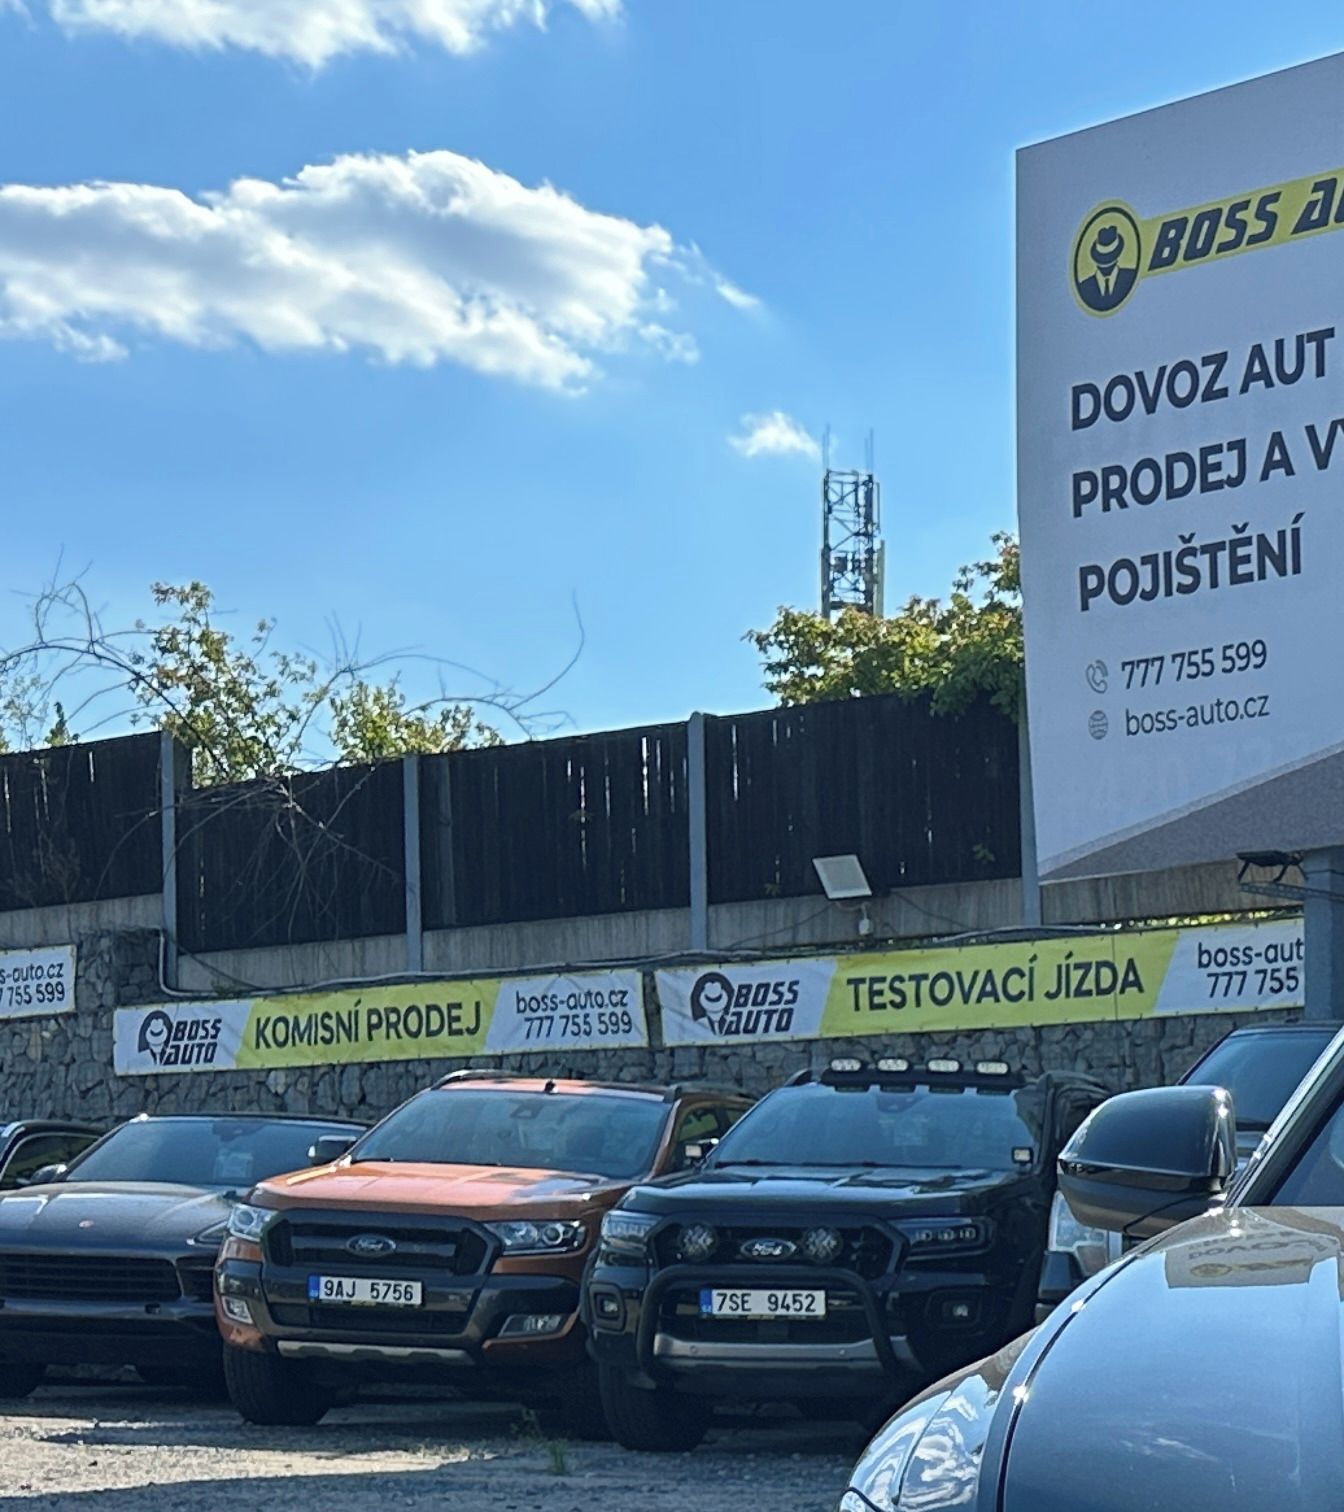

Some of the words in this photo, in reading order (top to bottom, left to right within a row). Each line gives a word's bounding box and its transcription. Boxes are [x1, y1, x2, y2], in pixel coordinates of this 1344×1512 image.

[1148, 192, 1282, 272] BOSS
[1071, 351, 1229, 430] DOVOZ
[1239, 327, 1336, 395] AUT
[1072, 440, 1246, 518] PRODEJ
[1260, 432, 1295, 482] A
[1078, 512, 1306, 611] POJIŠTĚNÍ
[1120, 659, 1166, 690] 777
[1171, 651, 1216, 682] 755
[1220, 639, 1268, 675] 599
[1125, 694, 1270, 737] boss-auto.cz
[7, 984, 33, 1007] 755
[36, 981, 66, 1003] 599
[734, 980, 800, 1008] BOSS
[846, 954, 1036, 1012] TESTOVACÍ
[1044, 952, 1145, 999] JÍZDA
[1206, 970, 1248, 998] 777
[1254, 967, 1300, 995] 755
[515, 989, 628, 1015] boss-auto.cz
[173, 1018, 222, 1042] BOSS
[255, 1001, 360, 1050] KOMISNÍ
[367, 1001, 481, 1041] PRODEJ
[523, 1016, 559, 1040] 777
[562, 1013, 594, 1037] 755
[597, 1011, 633, 1035] 599
[724, 1006, 793, 1035] AUTO
[164, 1041, 218, 1065] AUTO
[324, 1279, 356, 1299] 9AJ
[370, 1282, 414, 1302] 5756
[716, 1292, 752, 1312] 7SE
[767, 1293, 816, 1313] 9452
